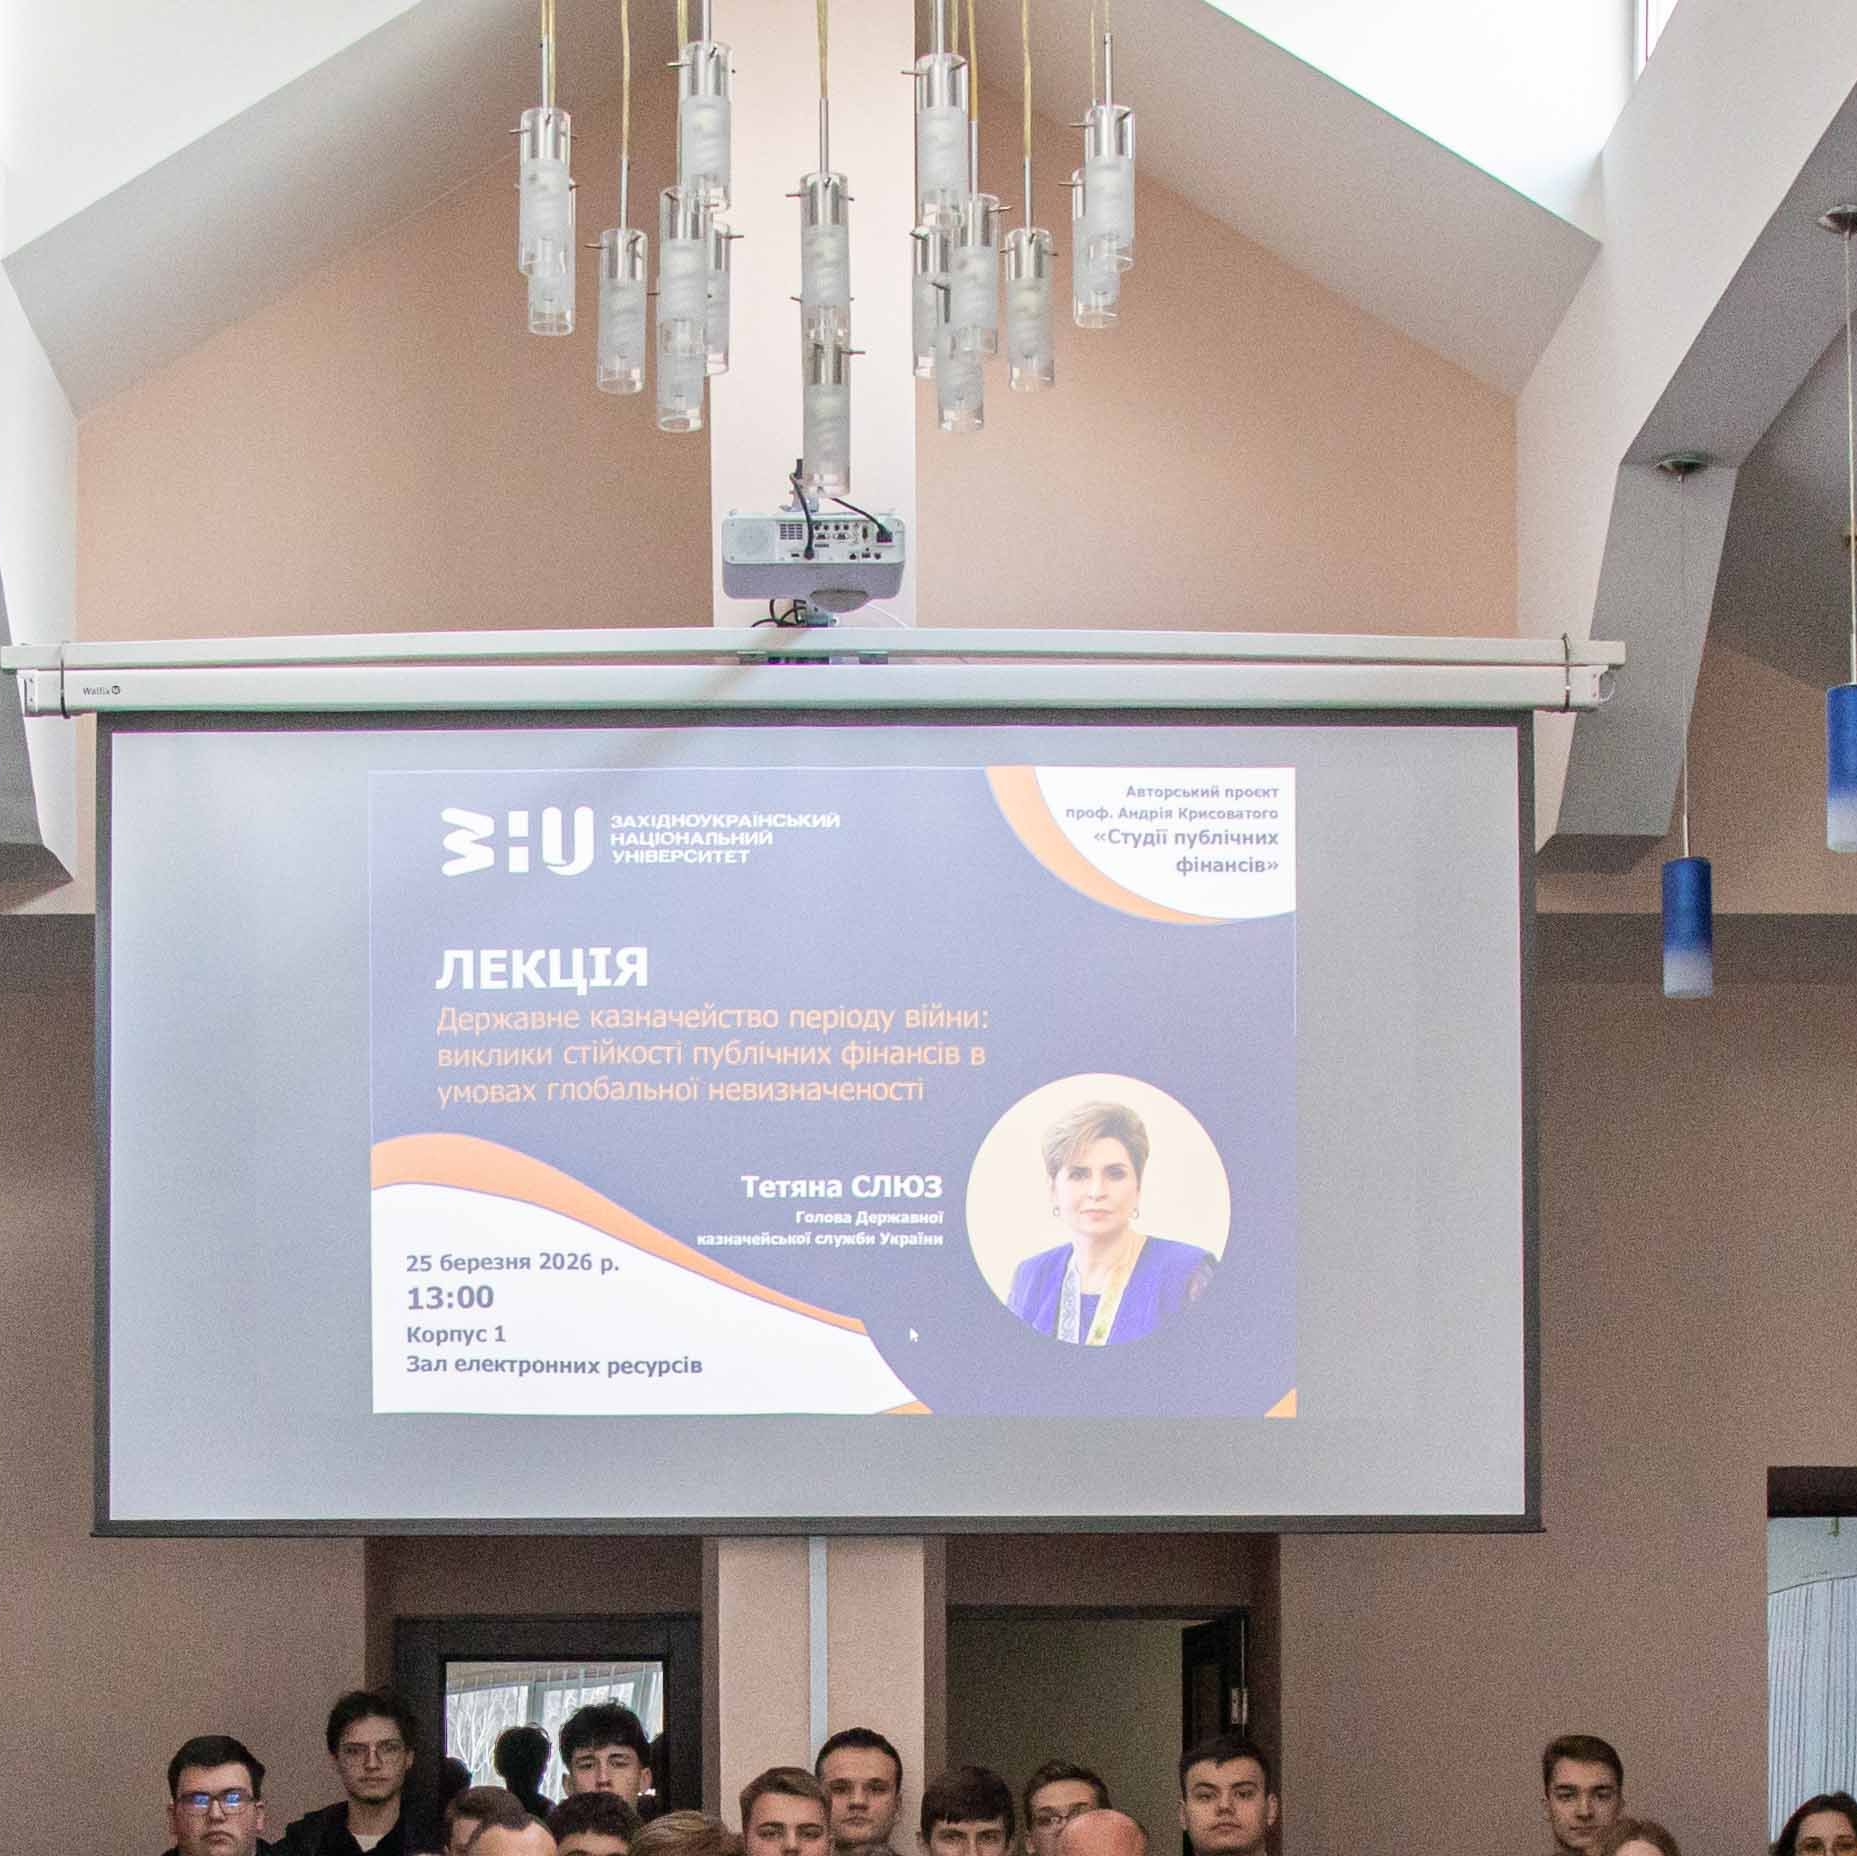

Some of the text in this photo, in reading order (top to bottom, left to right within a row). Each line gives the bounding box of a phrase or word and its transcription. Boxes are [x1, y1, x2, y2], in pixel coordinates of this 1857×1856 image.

[1125, 785, 1279, 800] Авторський проєкт
[609, 812, 841, 829] ЗАХІДНОУКРАЇНСЬКИЙ
[1065, 807, 1279, 821] проф. Андрія Крисоватого
[609, 831, 774, 848] НАЦІОНАЛЬНИЙ
[1093, 828, 1279, 849] «Студії публічних
[610, 848, 750, 865] УНІВЕРСИТЕТ
[1176, 856, 1279, 876] фінансів»
[435, 946, 649, 996] ЛЕКЦІЯ
[436, 1001, 990, 1037] Державне казначейство періоду війни:
[438, 1038, 987, 1070] виклики стійкості публічних фінансів в
[437, 1075, 924, 1111] умовах глобальної невизначеності
[741, 1175, 943, 1198] Тетяна СЛЮЗ
[795, 1210, 945, 1227] Голова Державної
[696, 1231, 944, 1248] казначейської служби України
[406, 1252, 620, 1275] 25 березня 2026 р.
[407, 1285, 495, 1310] 13:00
[406, 1325, 506, 1346] Корпус 1
[406, 1356, 703, 1378] Зал електронних ресурсів
